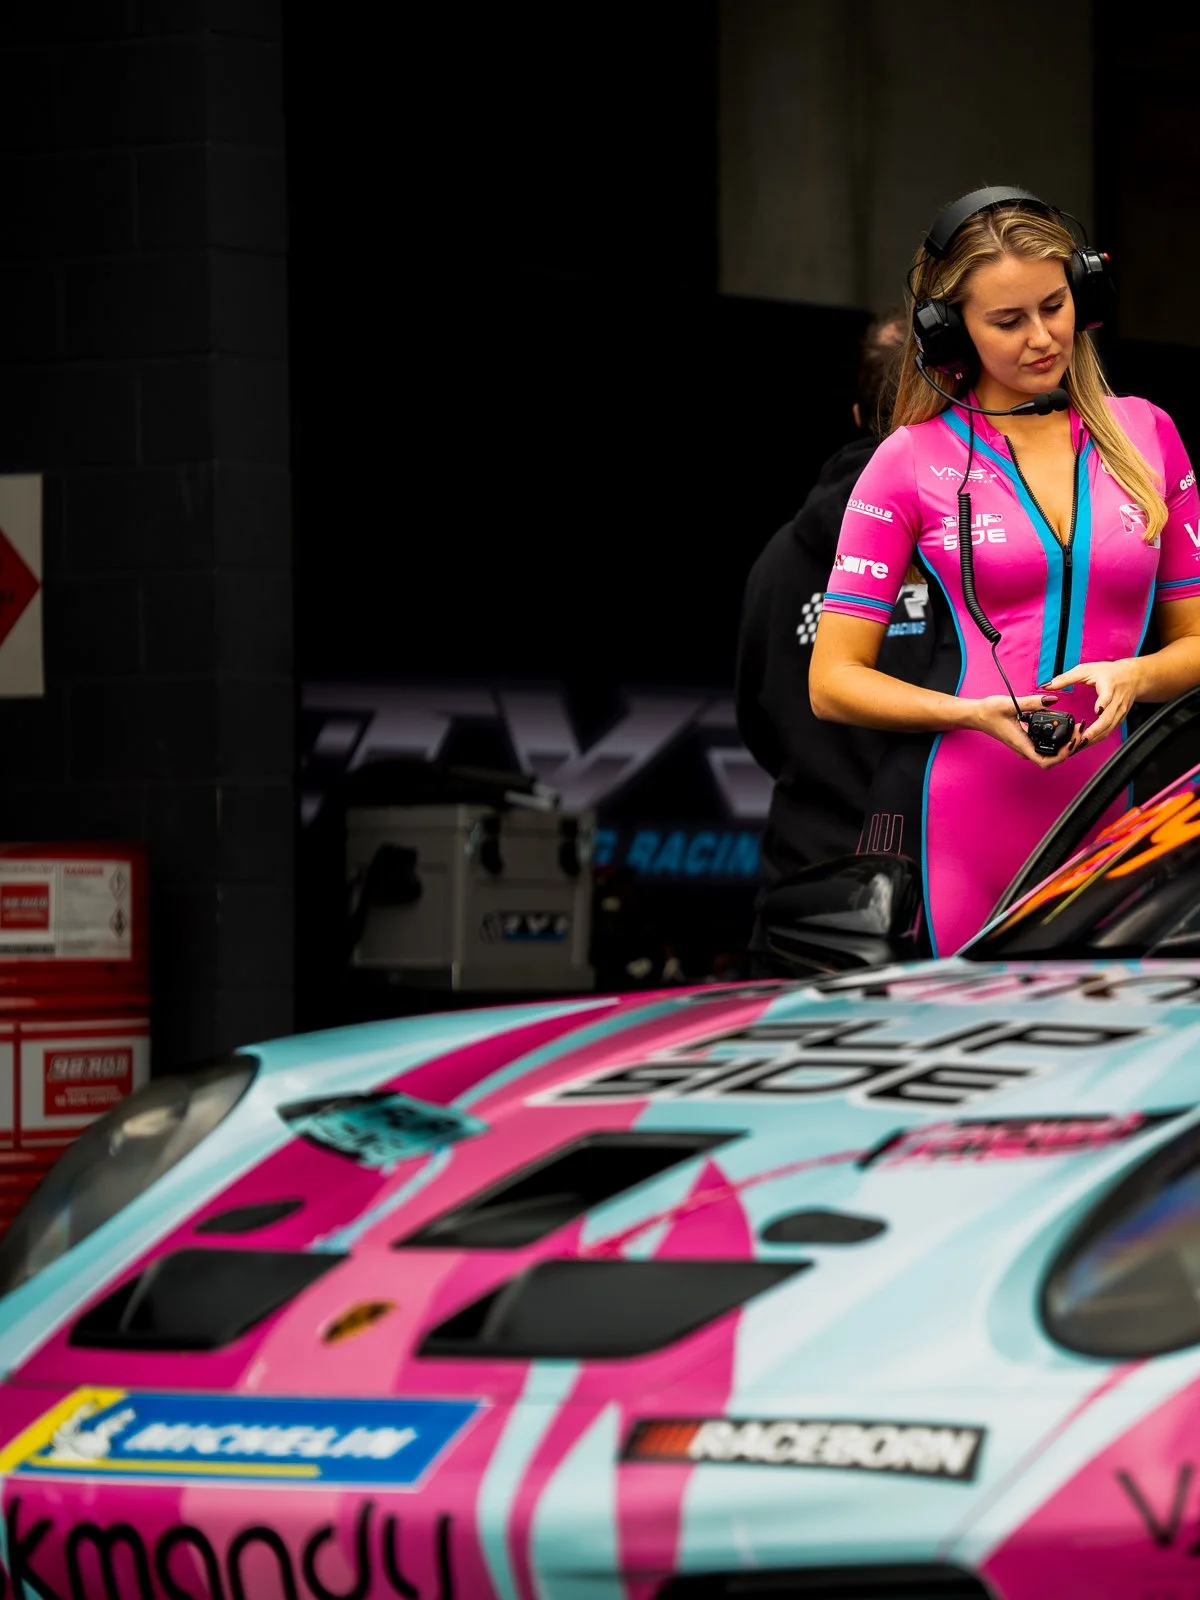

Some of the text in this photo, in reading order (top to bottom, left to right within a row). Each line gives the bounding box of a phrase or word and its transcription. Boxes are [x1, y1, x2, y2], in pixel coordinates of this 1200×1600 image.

[668, 1019, 1152, 1056] FLIP
[556, 1056, 1038, 1105] SIDE
[123, 1423, 418, 1459] MICHELIN
[689, 1420, 980, 1475] RACEBORN
[0, 1494, 455, 1600] kmandy
